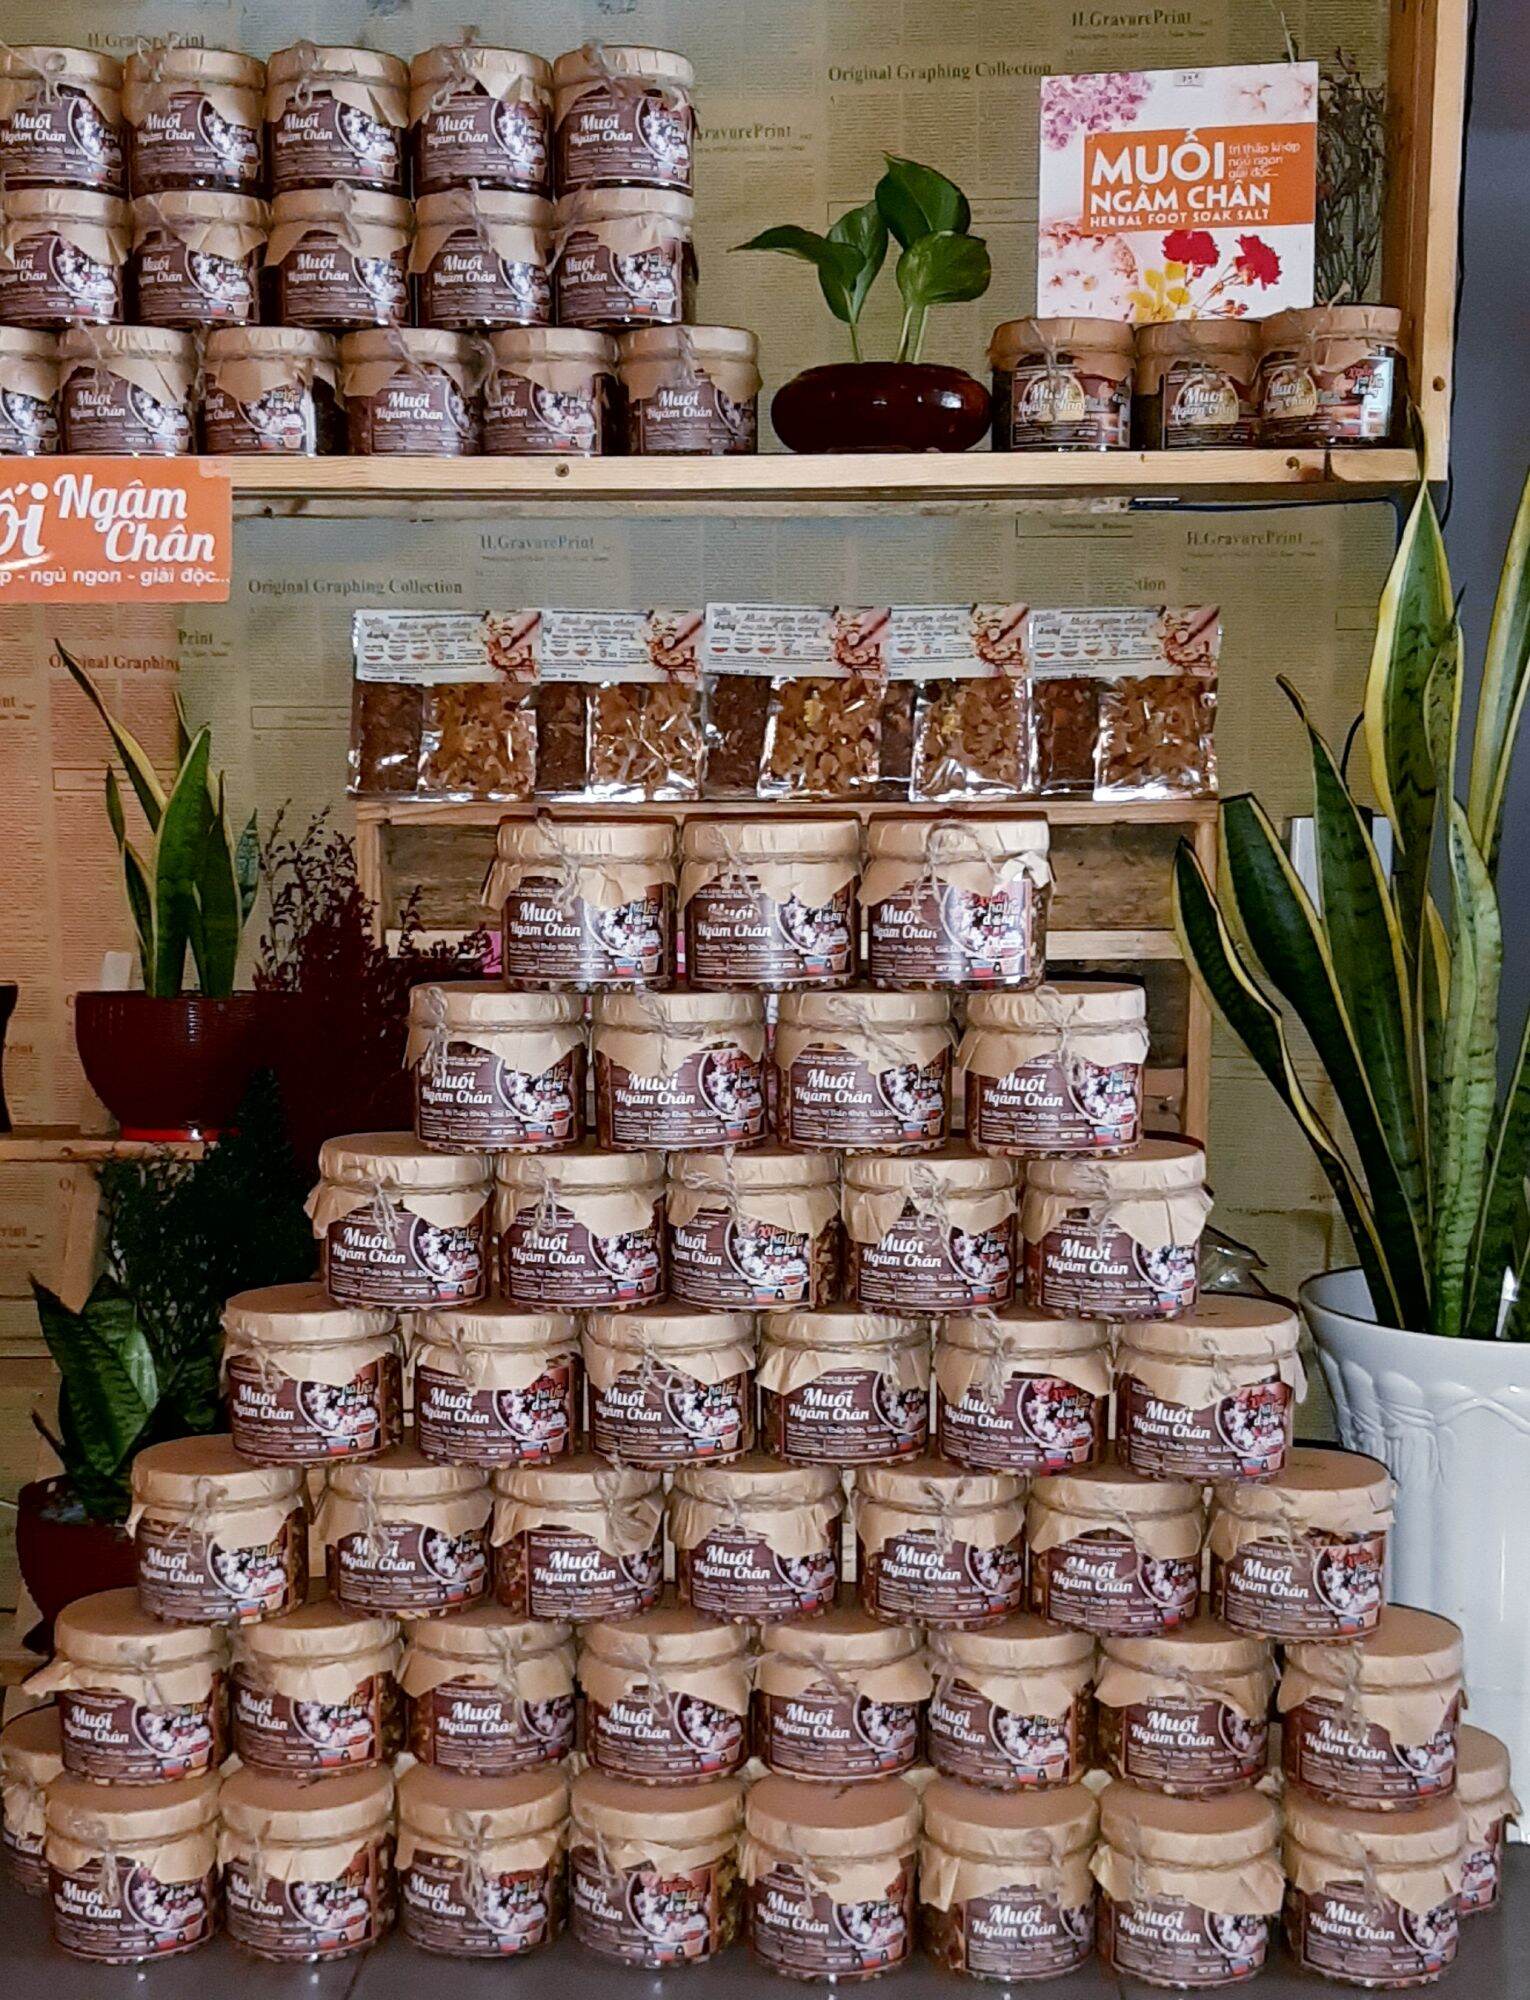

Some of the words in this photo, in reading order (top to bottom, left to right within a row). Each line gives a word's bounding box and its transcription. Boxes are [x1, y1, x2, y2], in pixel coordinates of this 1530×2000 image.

[828, 66, 892, 85] Original
[896, 63, 971, 82] Graphing
[1091, 128, 1225, 186] MUỐI
[1090, 184, 1179, 215] NGÂM
[1188, 179, 1271, 209] CHÂN
[1090, 212, 1142, 228] HERBAL
[1148, 211, 1187, 225] FOOT
[1193, 210, 1231, 223] SOAK
[1237, 208, 1269, 220] SALT
[53, 474, 187, 532] Ngâm
[105, 520, 216, 563] Chân
[30, 567, 66, 586] ngủ
[73, 570, 121, 586] ngon
[140, 568, 175, 586] giải
[248, 579, 309, 598] Original
[313, 579, 385, 599] Graphing
[389, 580, 462, 595] Collection
